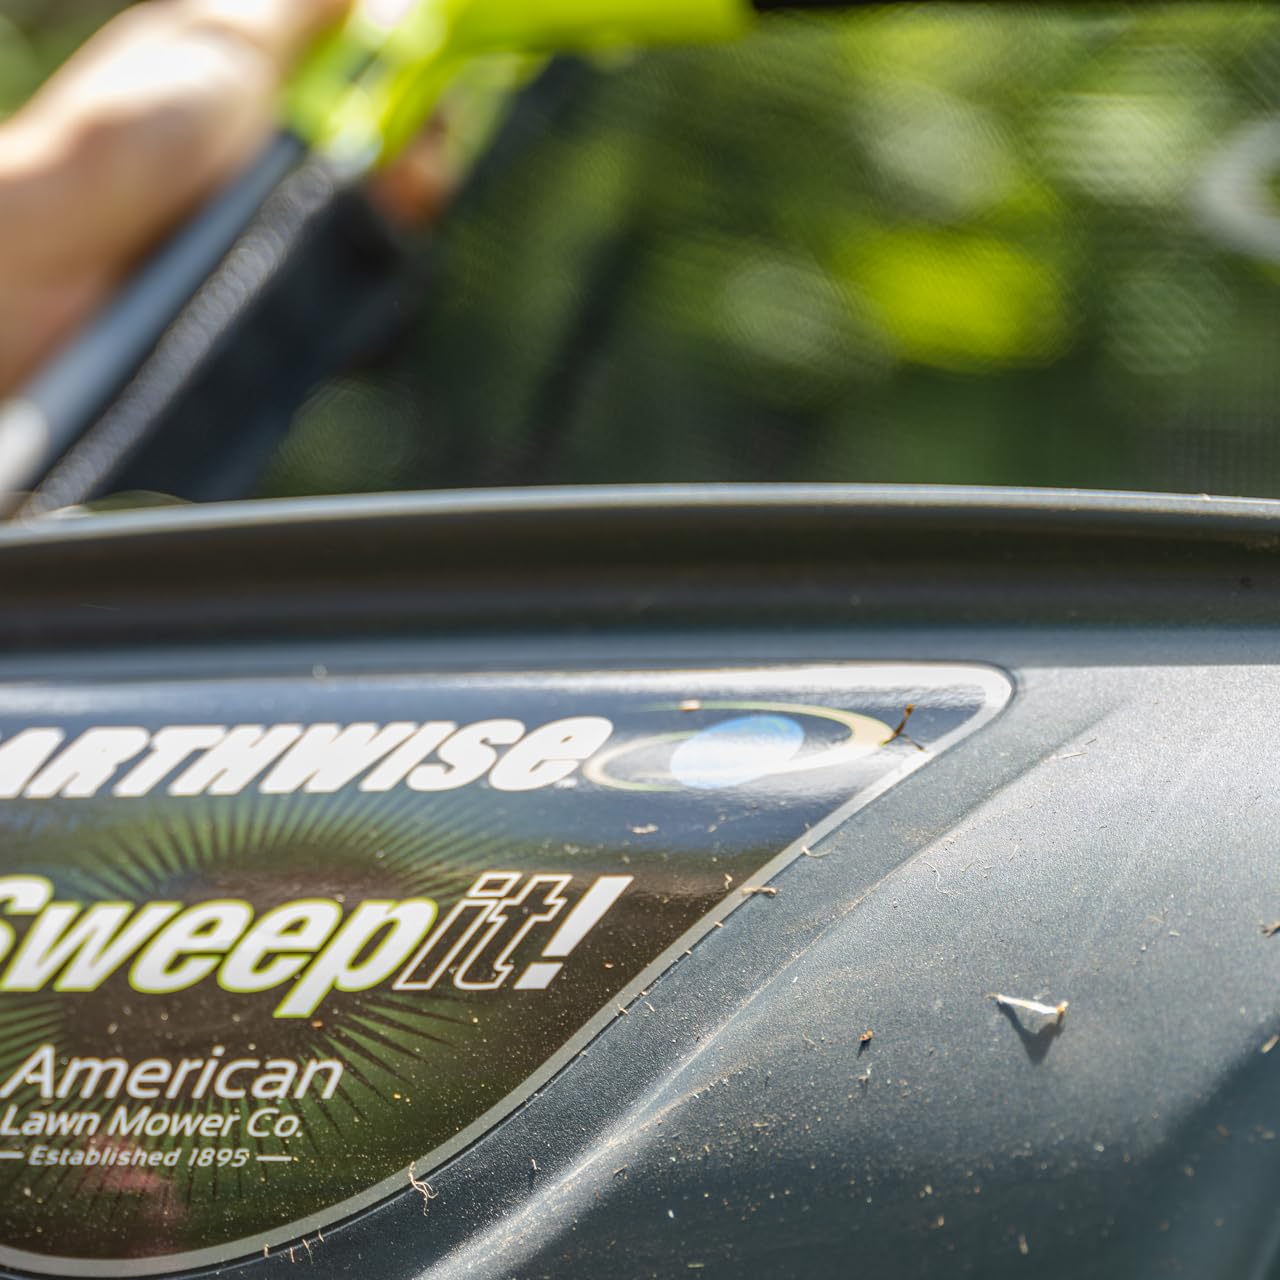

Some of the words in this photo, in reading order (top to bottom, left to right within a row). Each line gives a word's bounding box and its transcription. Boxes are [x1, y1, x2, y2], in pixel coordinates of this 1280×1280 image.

[107, 1106, 240, 1138] Mower
[246, 1108, 304, 1138] Co.
[28, 1145, 180, 1168] Established
[188, 1148, 249, 1168] 1895
